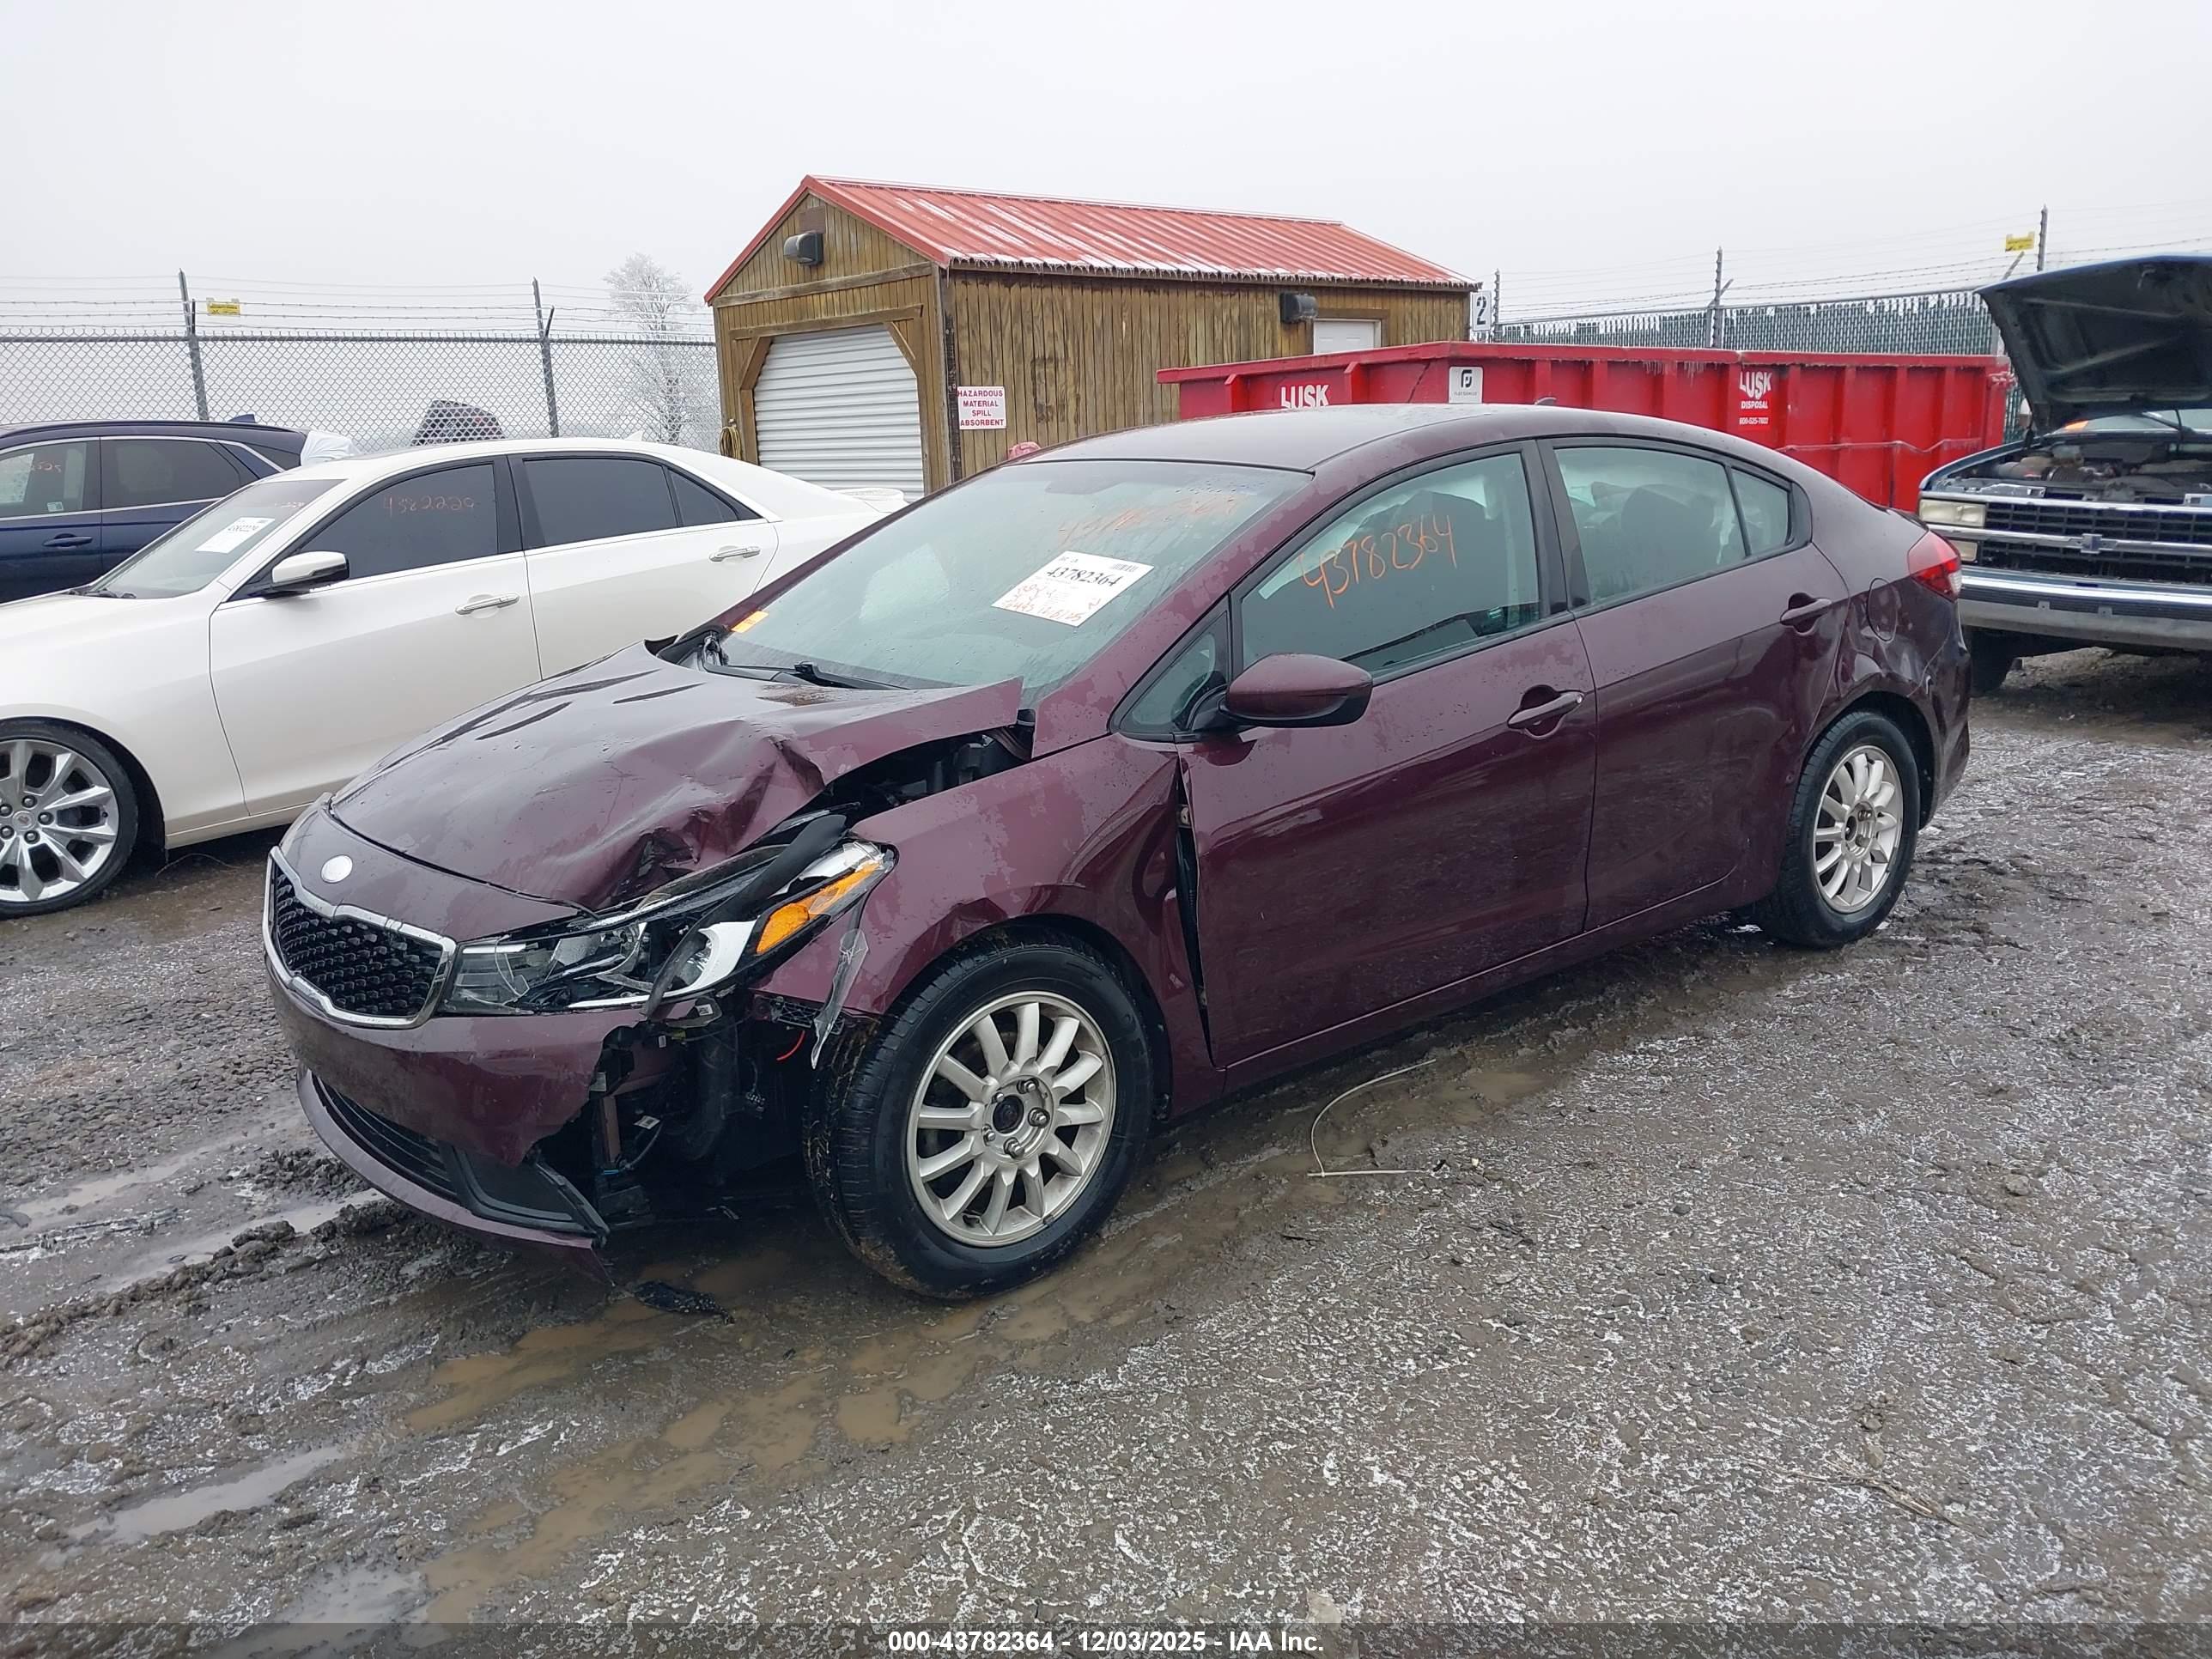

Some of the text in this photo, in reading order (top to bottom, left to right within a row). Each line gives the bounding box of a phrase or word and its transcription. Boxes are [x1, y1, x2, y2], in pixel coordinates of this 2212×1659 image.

[1476, 295, 1487, 325] 2
[1280, 384, 1329, 410] LUSK
[1739, 371, 1772, 400] LUSK
[1741, 400, 1769, 410] DISPOSAL
[960, 418, 1005, 427] ABSORBENT
[1297, 514, 1458, 610] 43782364
[1046, 565, 1124, 587] 43782364
